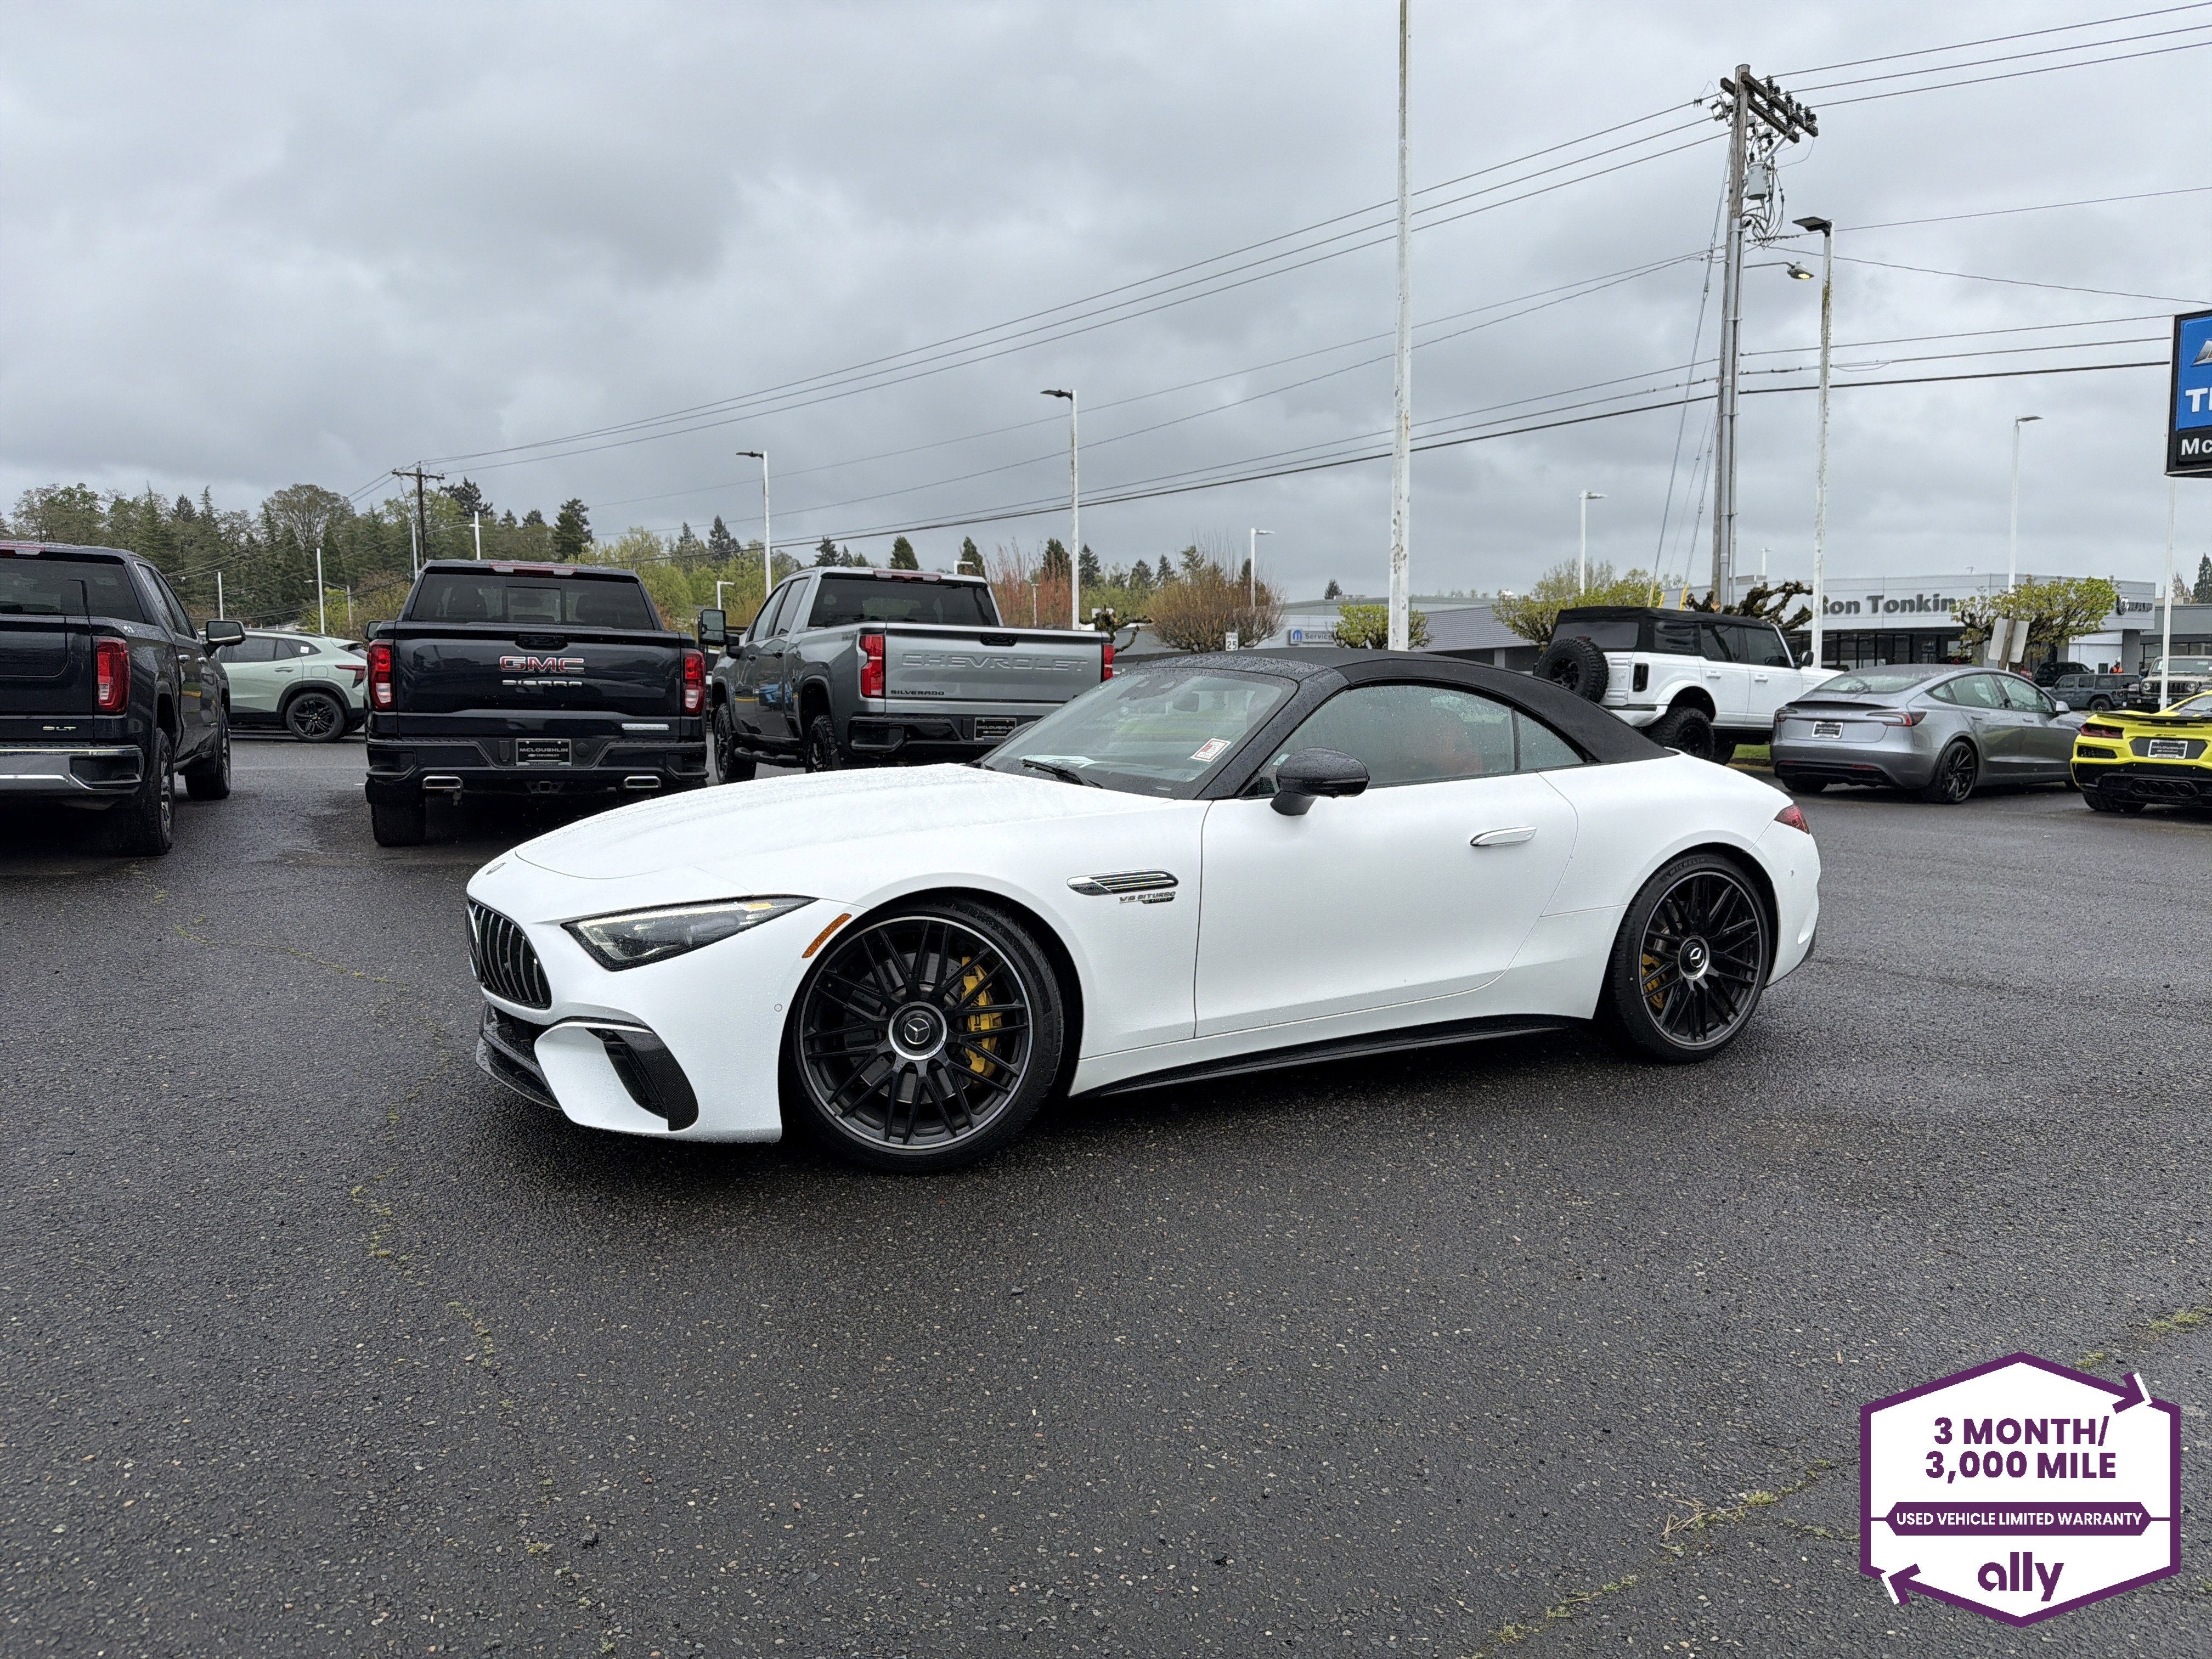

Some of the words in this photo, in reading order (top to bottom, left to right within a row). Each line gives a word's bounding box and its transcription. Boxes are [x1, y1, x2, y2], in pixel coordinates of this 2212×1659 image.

[2185, 387, 2212, 413] T
[1866, 593, 1956, 613] Tonkin
[1227, 640, 1237, 650] 25
[499, 655, 585, 674] GMC
[902, 653, 1089, 672] CHEVROLET
[1137, 891, 1176, 900] BITURBO
